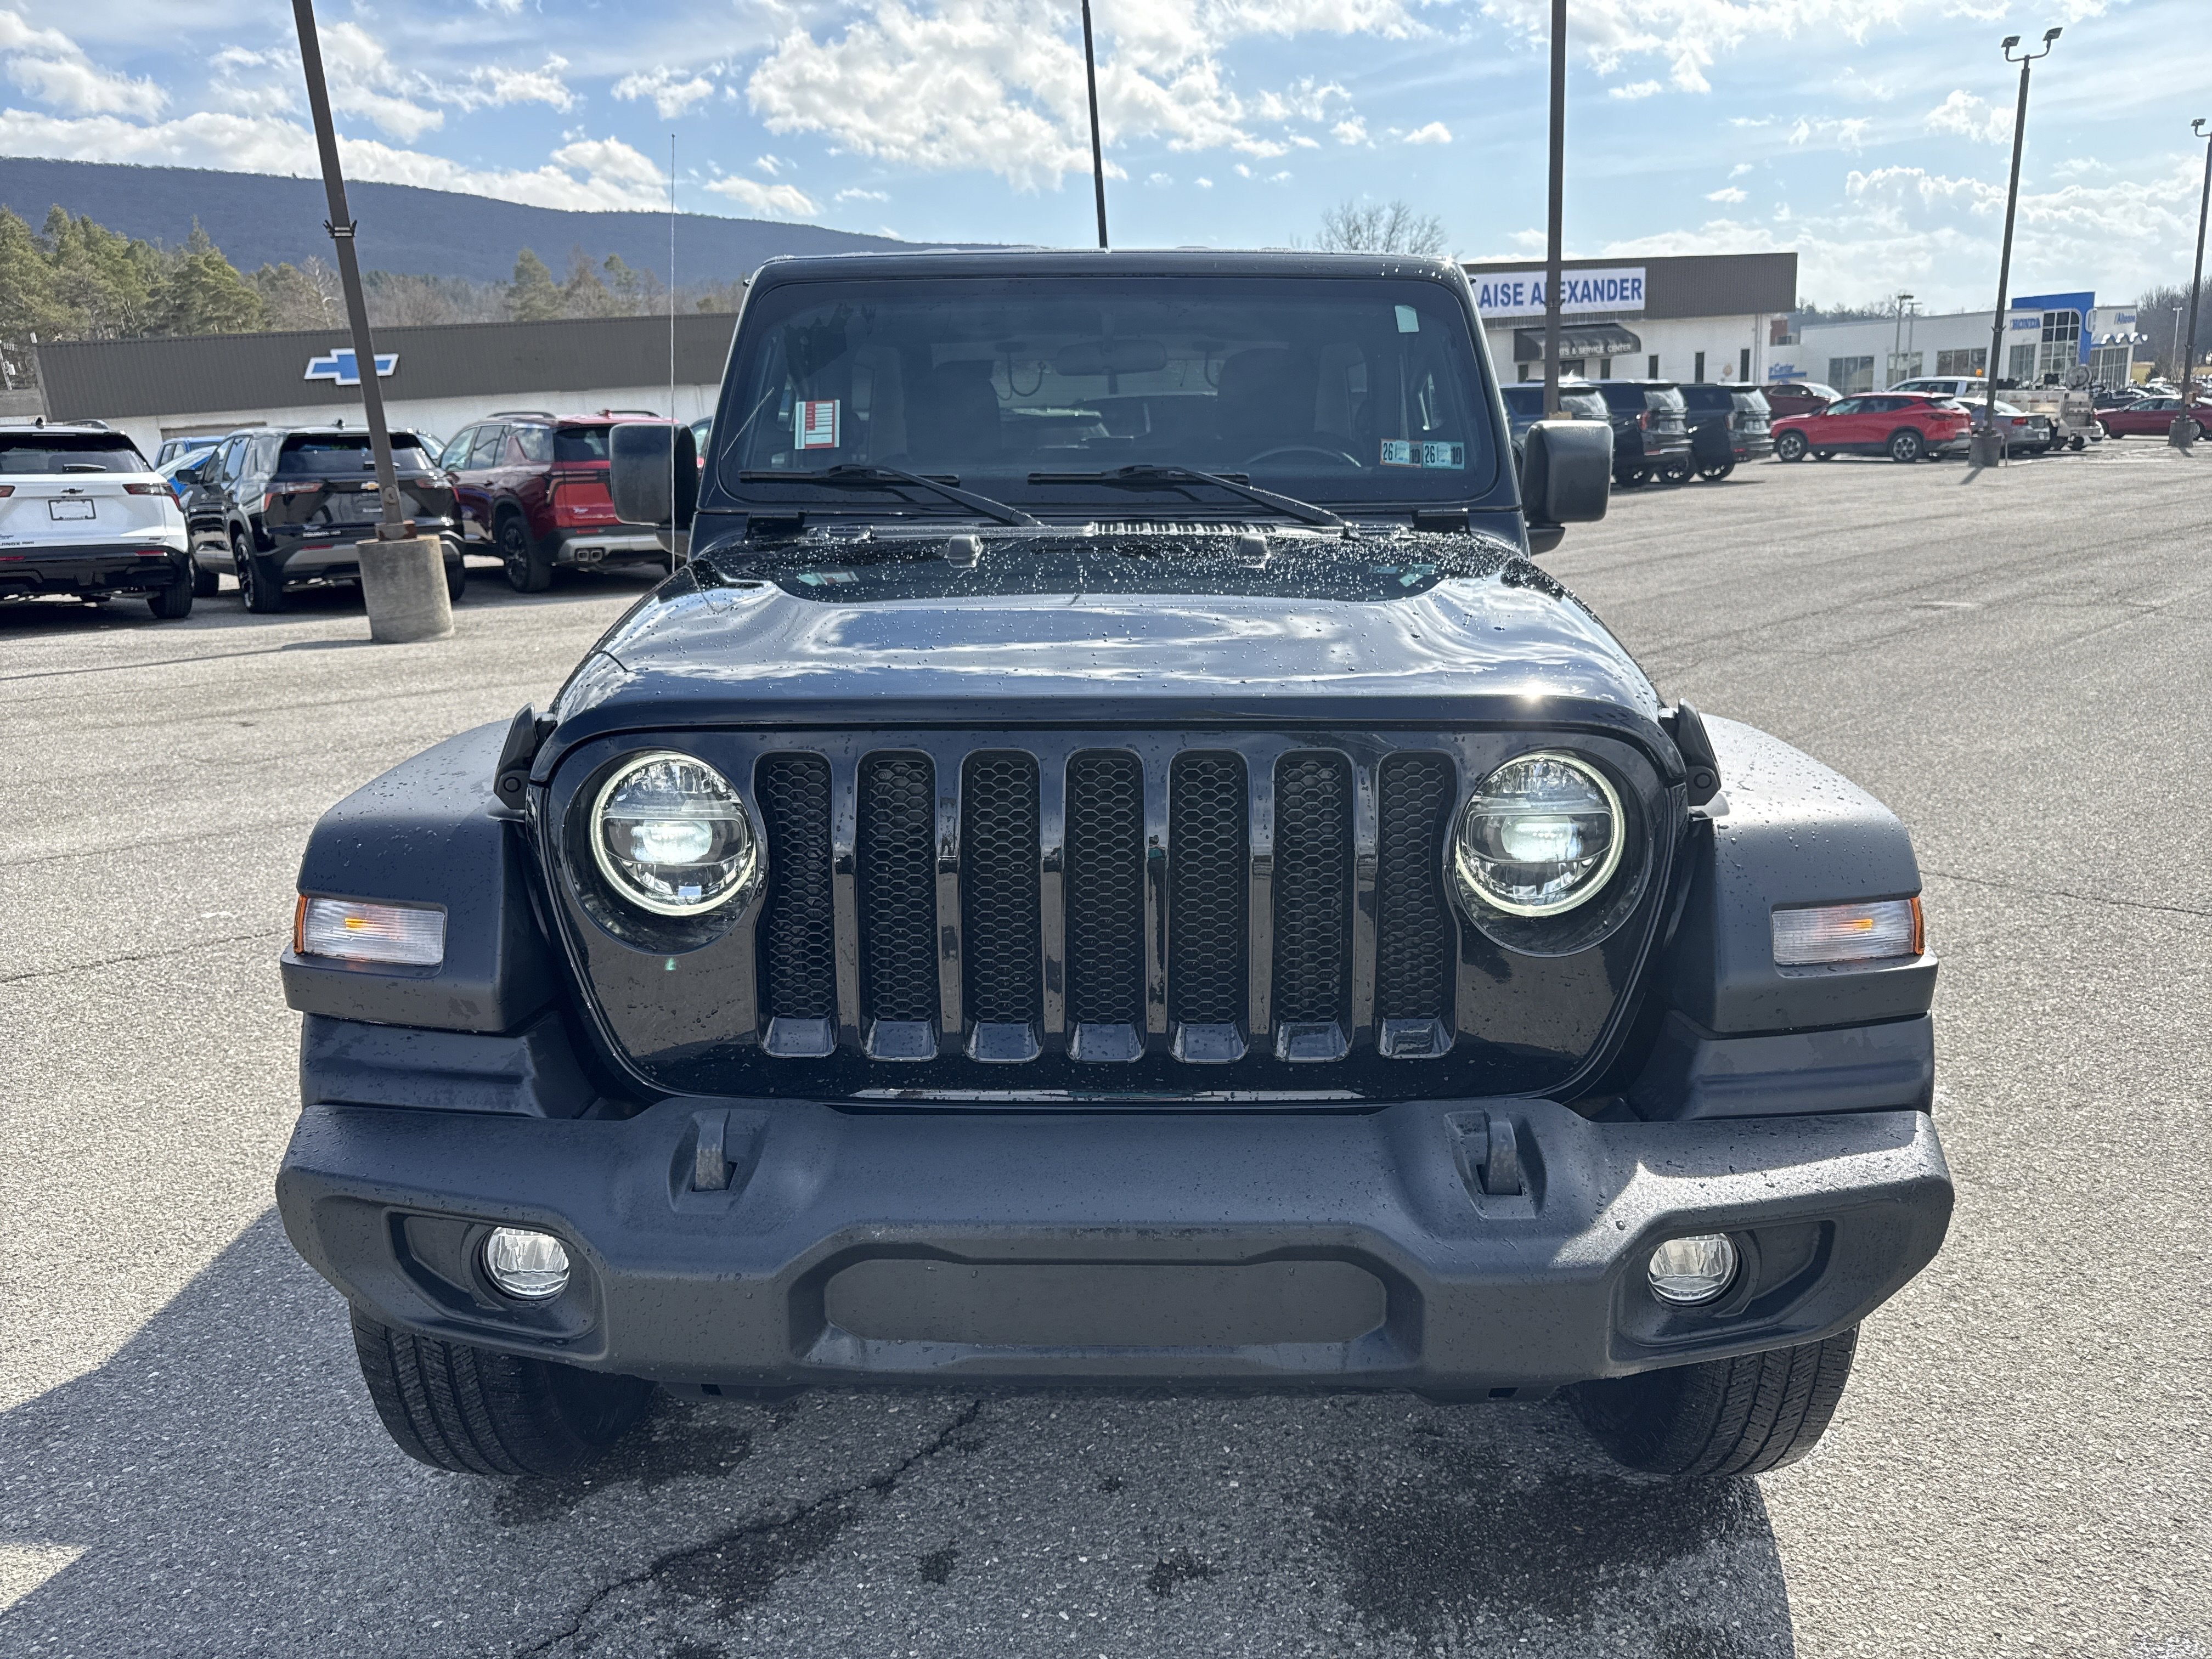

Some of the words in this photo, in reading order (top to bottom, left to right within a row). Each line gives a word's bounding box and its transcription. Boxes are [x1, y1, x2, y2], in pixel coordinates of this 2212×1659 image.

[1478, 283, 1523, 308] AISE
[2012, 317, 2040, 330] HONDA
[1578, 345, 1604, 354] SERVICE
[1607, 343, 1631, 352] CENTER
[1383, 443, 1393, 461] 26
[1425, 445, 1435, 464] 26
